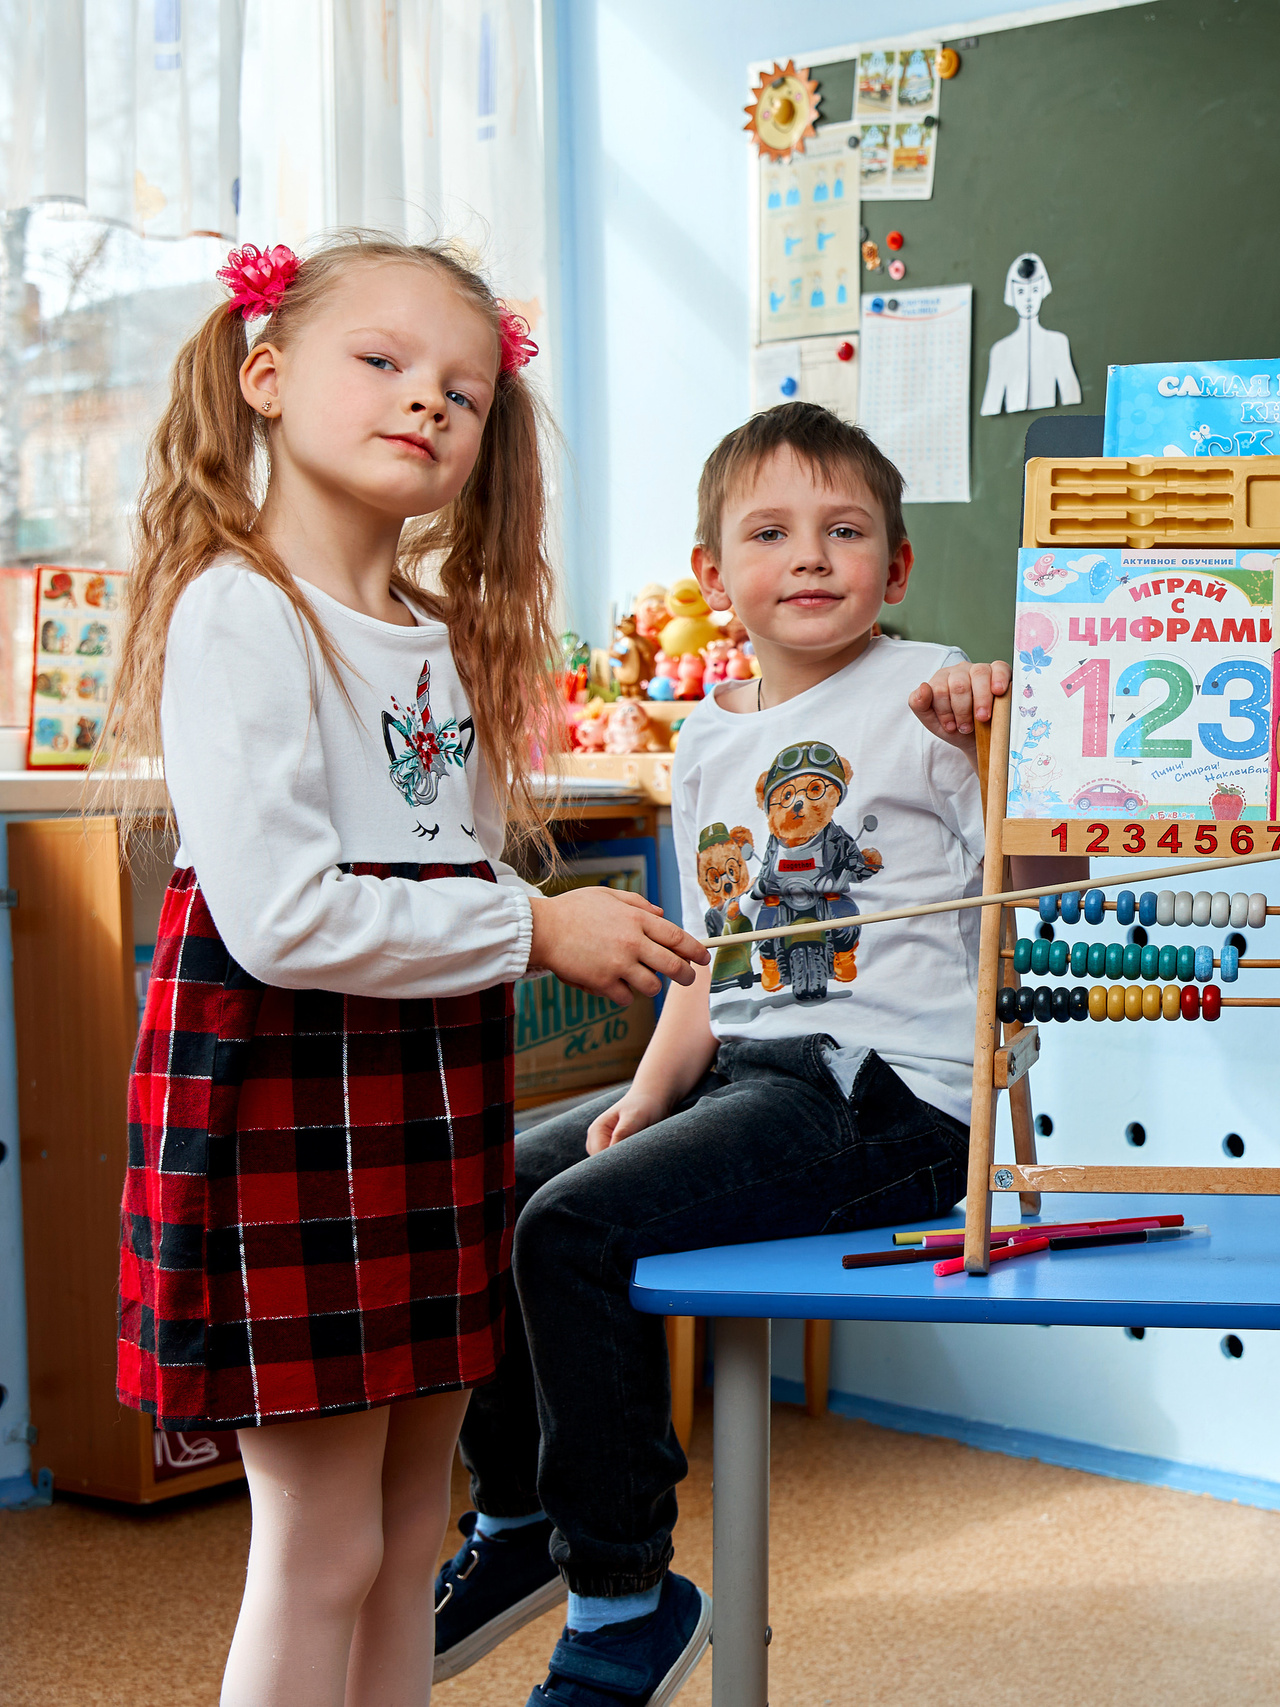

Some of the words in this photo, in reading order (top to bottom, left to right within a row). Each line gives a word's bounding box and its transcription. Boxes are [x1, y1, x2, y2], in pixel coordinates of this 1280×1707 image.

[1158, 374, 1271, 397] САМАЯ
[1123, 558, 1177, 566] АКТИВНОЕ
[1181, 558, 1235, 566] ОБУЧЕНИЕ
[1129, 577, 1228, 602] ИГРАЙ
[1171, 598, 1186, 613] С
[1151, 761, 1185, 781] Пиши!
[1174, 761, 1220, 783] Стирай!
[1051, 822, 1068, 852] 1
[1086, 823, 1110, 853] 2
[1122, 823, 1147, 853] 3
[1157, 824, 1183, 853] 4
[1194, 825, 1218, 854] 5
[1230, 825, 1255, 855] 6
